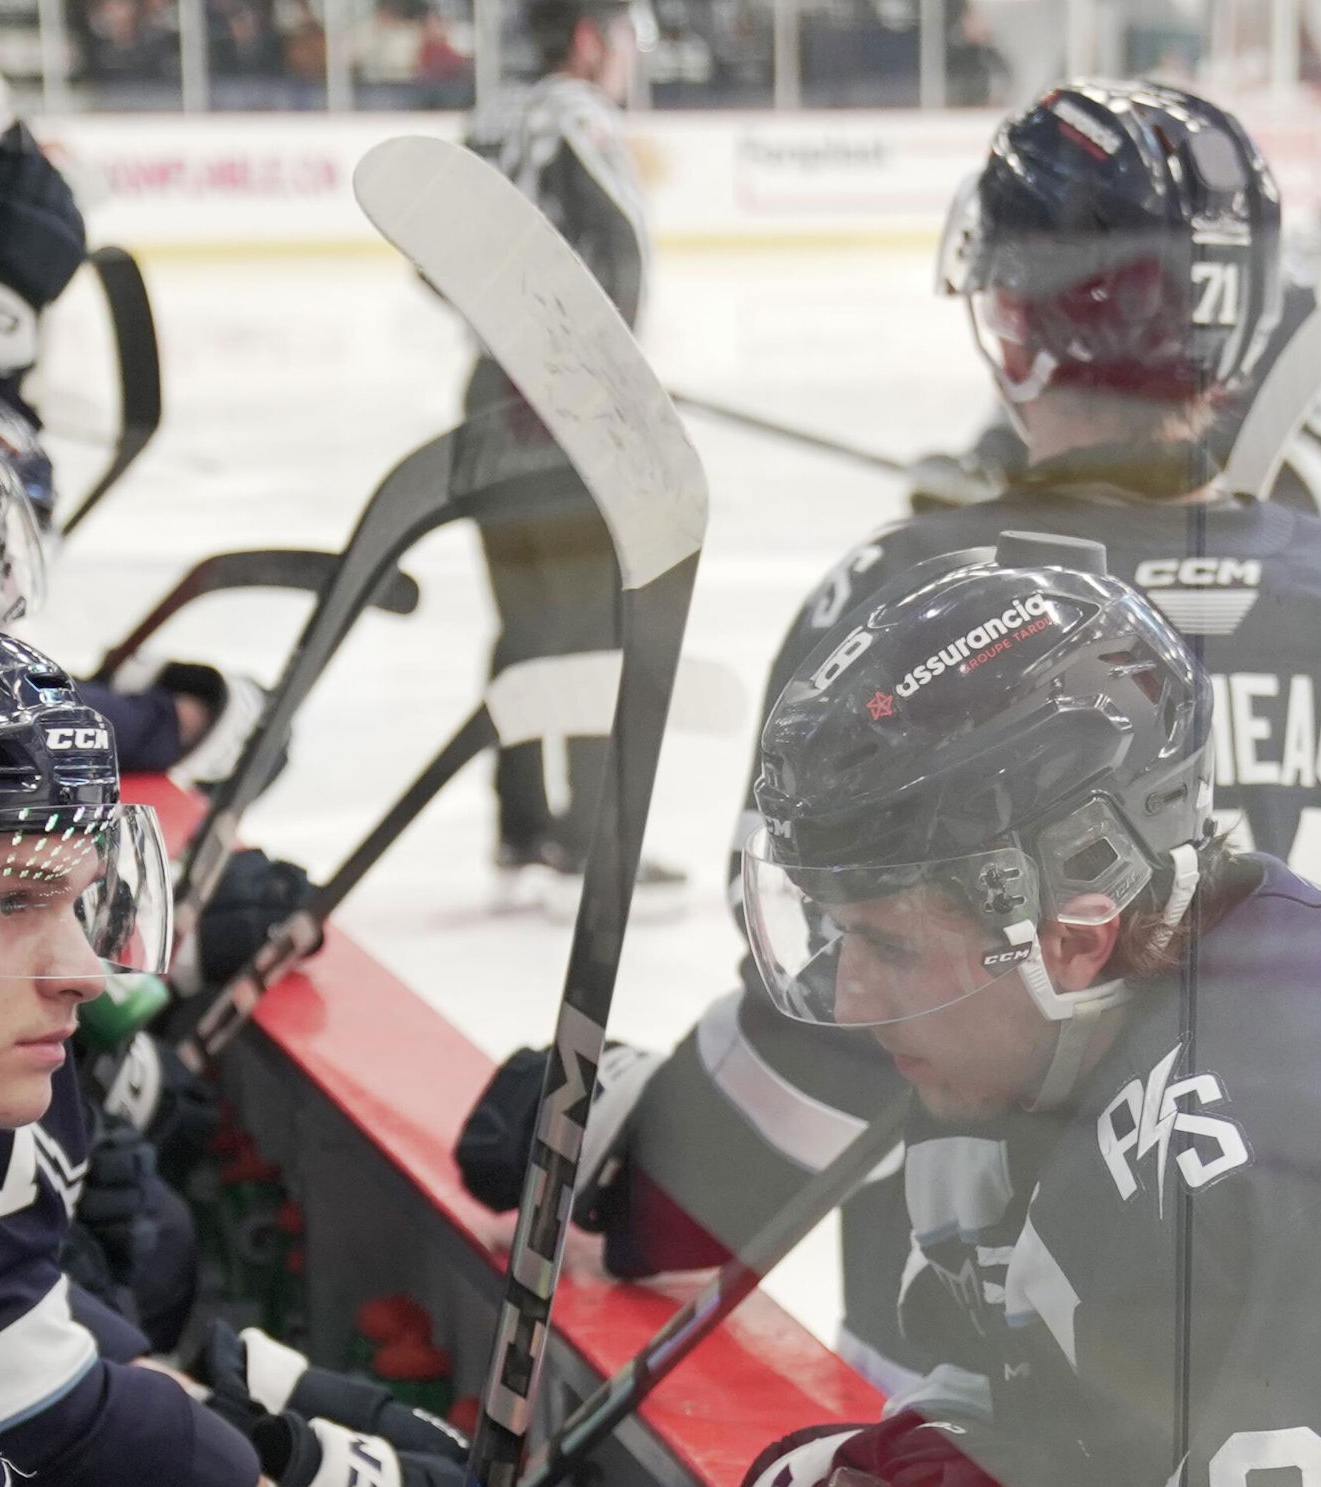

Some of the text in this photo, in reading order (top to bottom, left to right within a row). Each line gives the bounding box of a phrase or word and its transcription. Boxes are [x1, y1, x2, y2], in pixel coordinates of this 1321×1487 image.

[1190, 263, 1239, 325] 71
[1134, 558, 1263, 587] CCM
[1011, 612, 1058, 641] TARDI
[895, 590, 1057, 697] assurancia
[44, 728, 110, 750] CCM
[983, 949, 1031, 966] CCM
